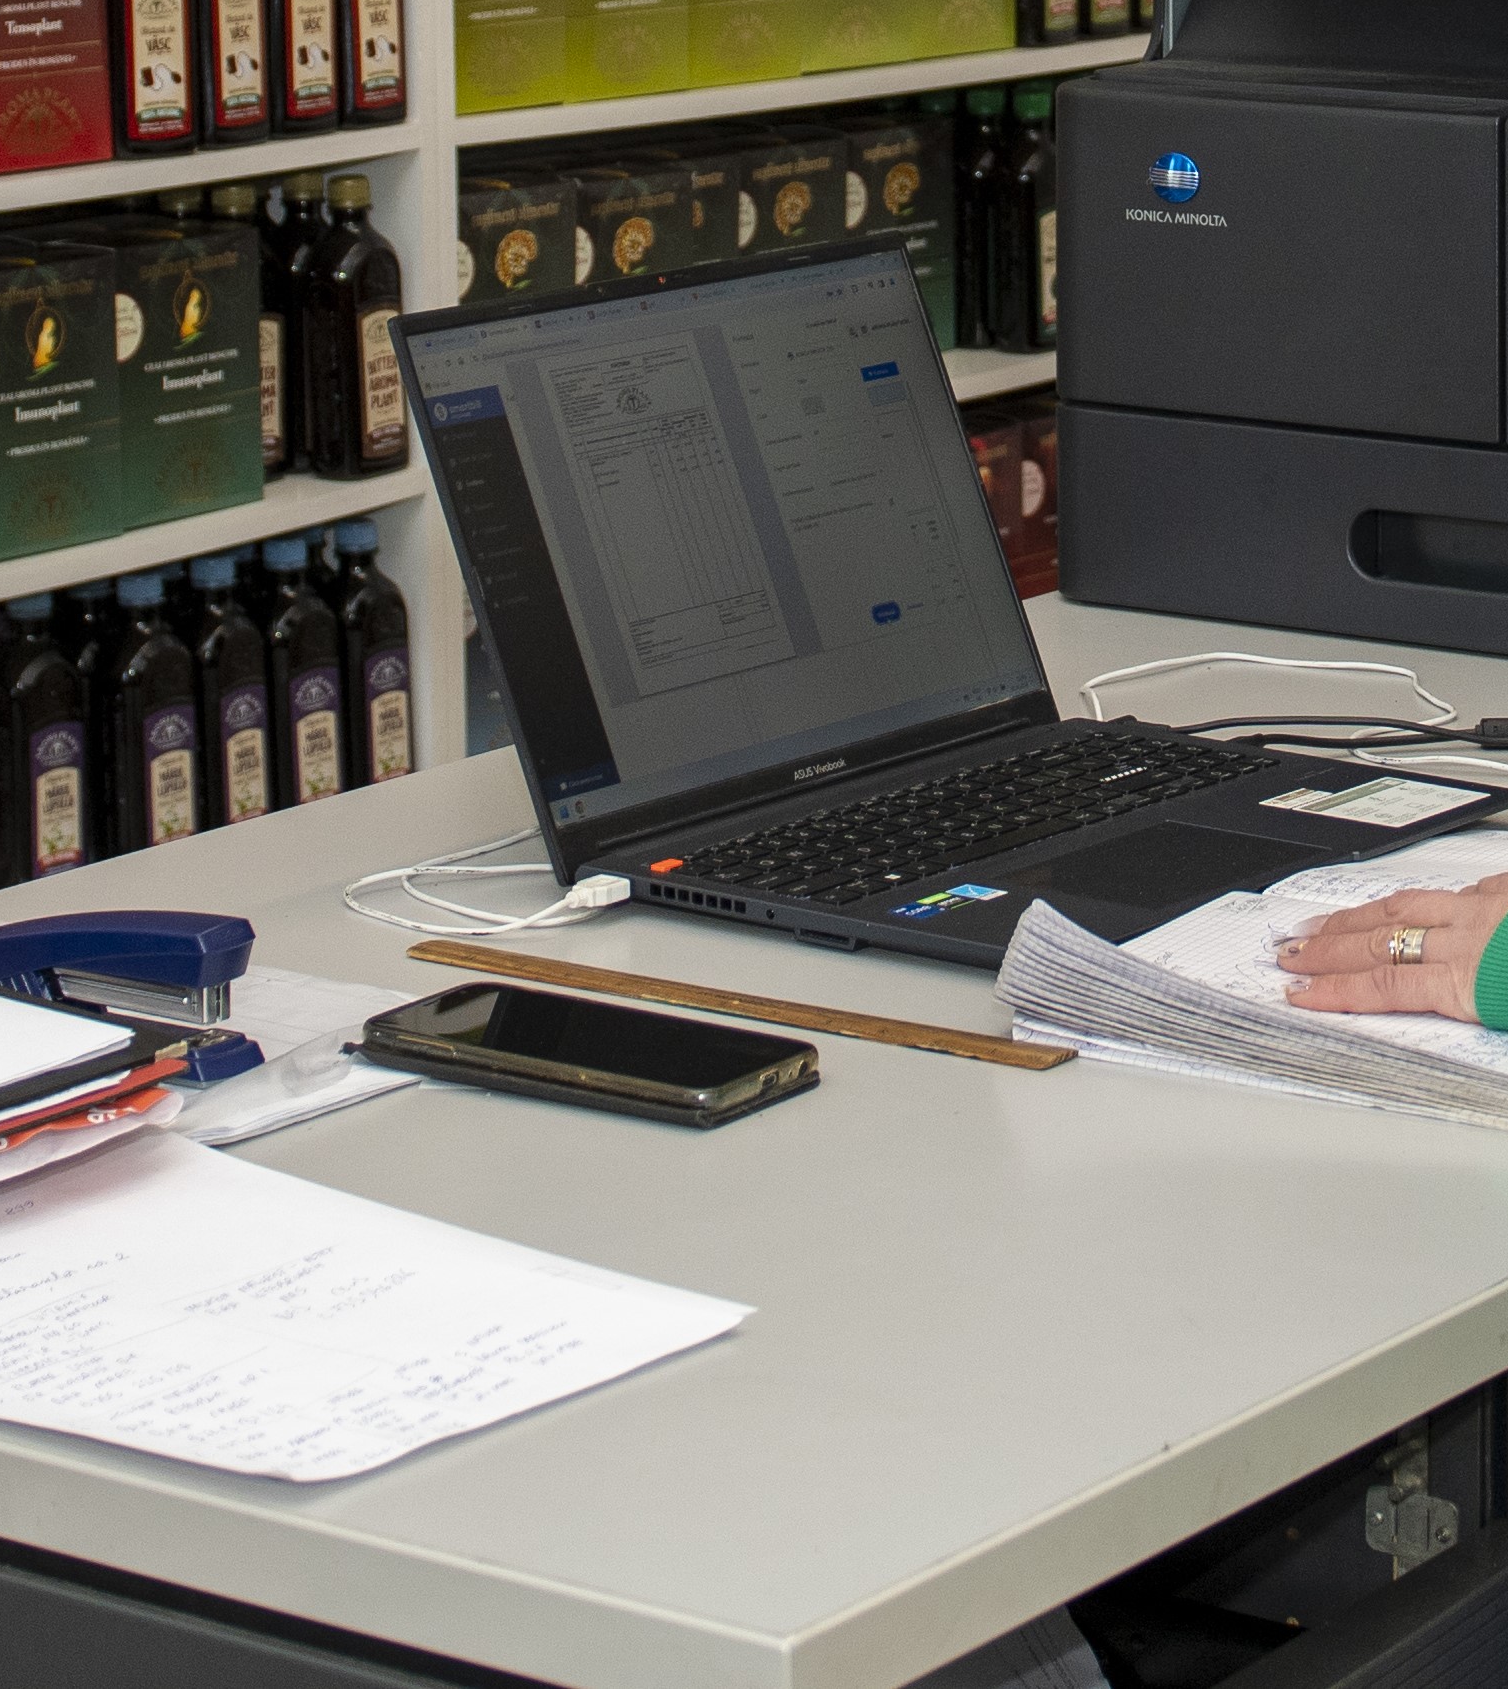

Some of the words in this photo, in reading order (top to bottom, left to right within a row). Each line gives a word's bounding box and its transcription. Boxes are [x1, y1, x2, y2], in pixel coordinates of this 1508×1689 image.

[4, 16, 63, 37] Tensoplant
[1125, 208, 1172, 224] KONICA
[1174, 213, 1227, 227] MINOLTA
[162, 368, 225, 392] Imunoplant
[13, 400, 81, 423] Imunoplant
[794, 766, 814, 781] ASUS
[815, 758, 846, 775] Vivobook
